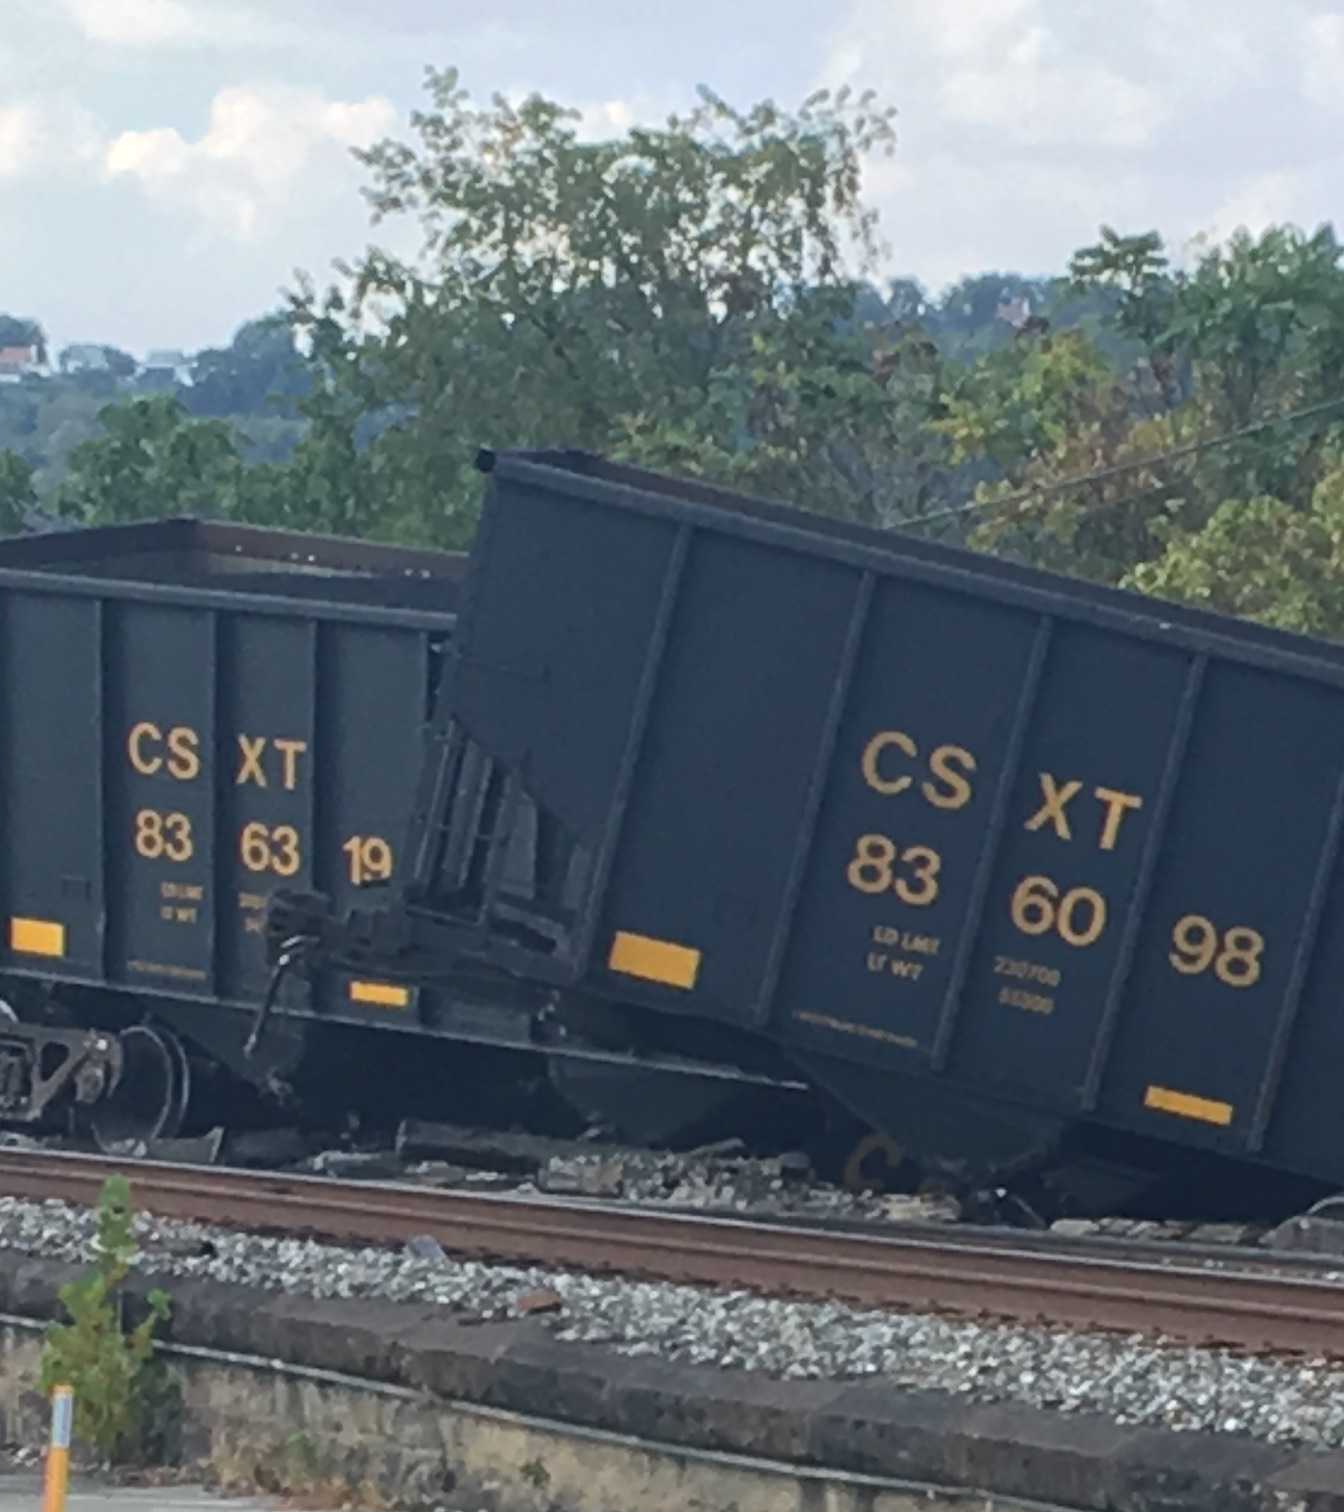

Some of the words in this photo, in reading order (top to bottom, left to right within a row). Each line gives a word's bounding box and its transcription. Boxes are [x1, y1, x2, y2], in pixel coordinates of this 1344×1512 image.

[128, 721, 200, 780] CS
[237, 734, 307, 790] XT
[862, 730, 976, 810] CS
[1025, 772, 1143, 850] XT
[136, 809, 194, 862] 83
[240, 822, 301, 876] 63
[342, 836, 393, 885] 19
[847, 834, 941, 906] 83
[1010, 875, 1106, 946] 60
[1169, 915, 1264, 987] 98
